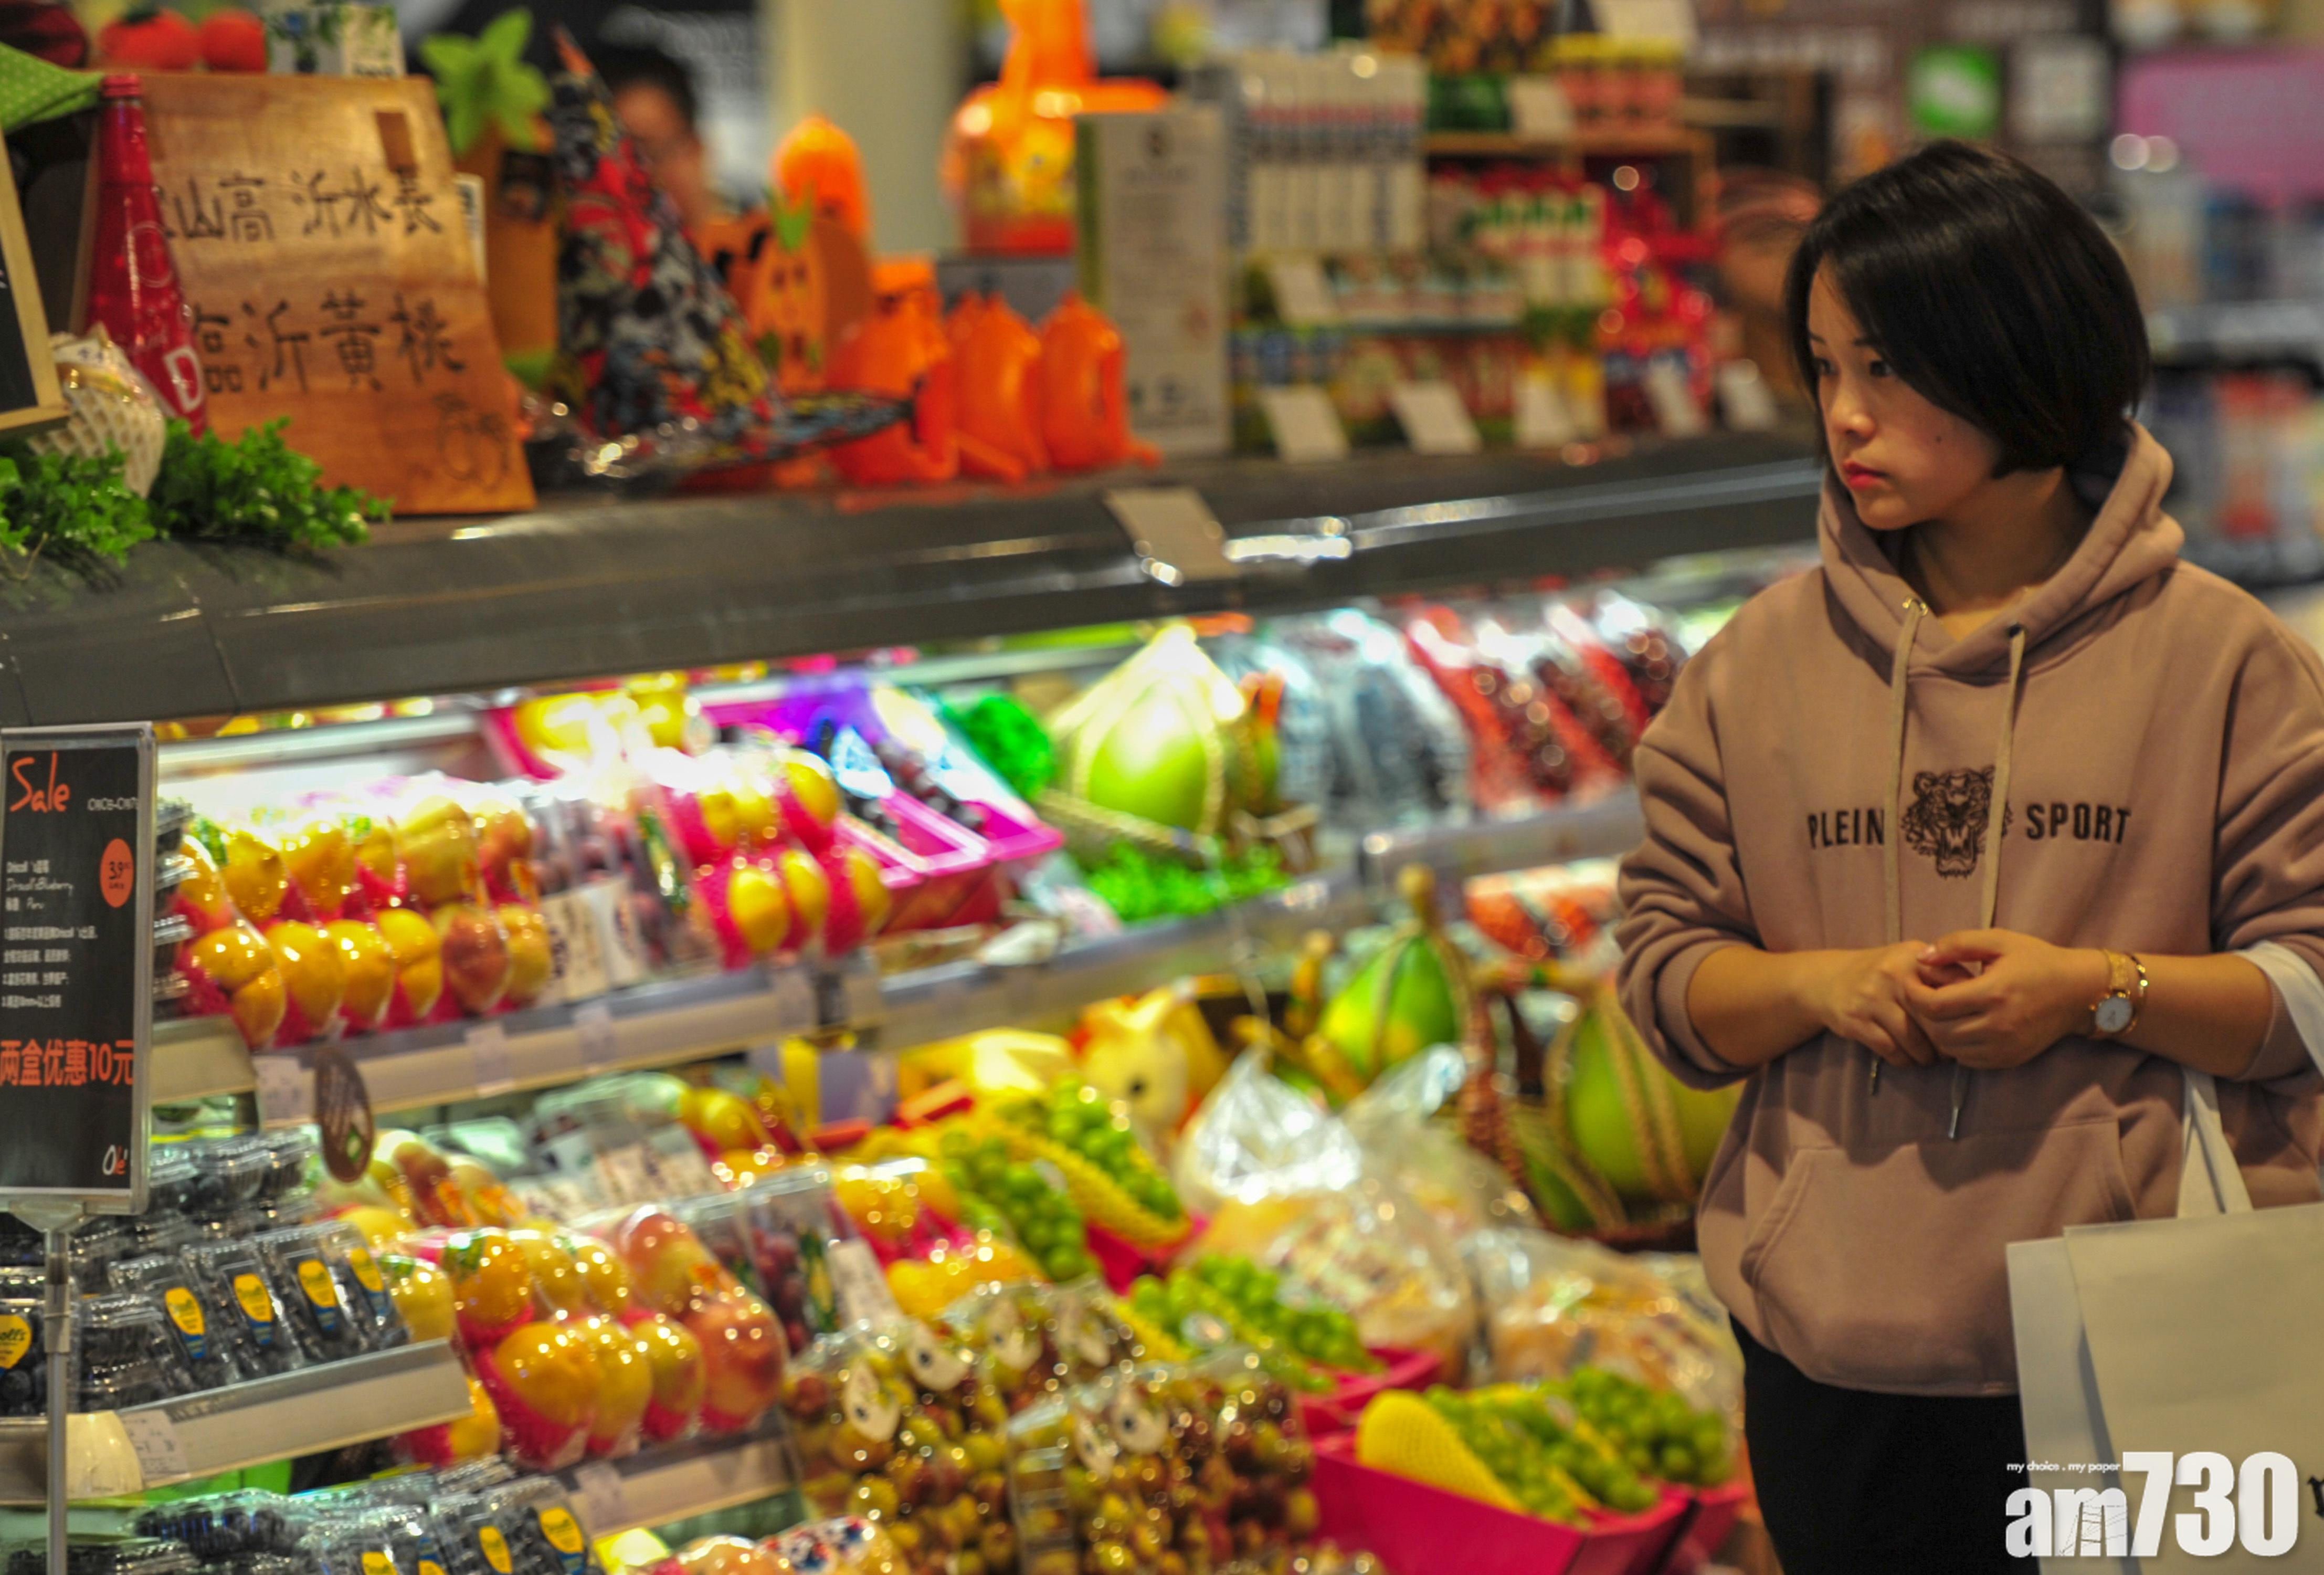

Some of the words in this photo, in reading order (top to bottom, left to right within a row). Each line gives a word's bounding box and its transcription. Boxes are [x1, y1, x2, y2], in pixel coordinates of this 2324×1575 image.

[9, 751, 71, 813] Sale
[1807, 807, 1885, 849] PLEIN
[2025, 802, 2131, 844] SPORT
[0, 1038, 134, 1087] 两盒优惠10元
